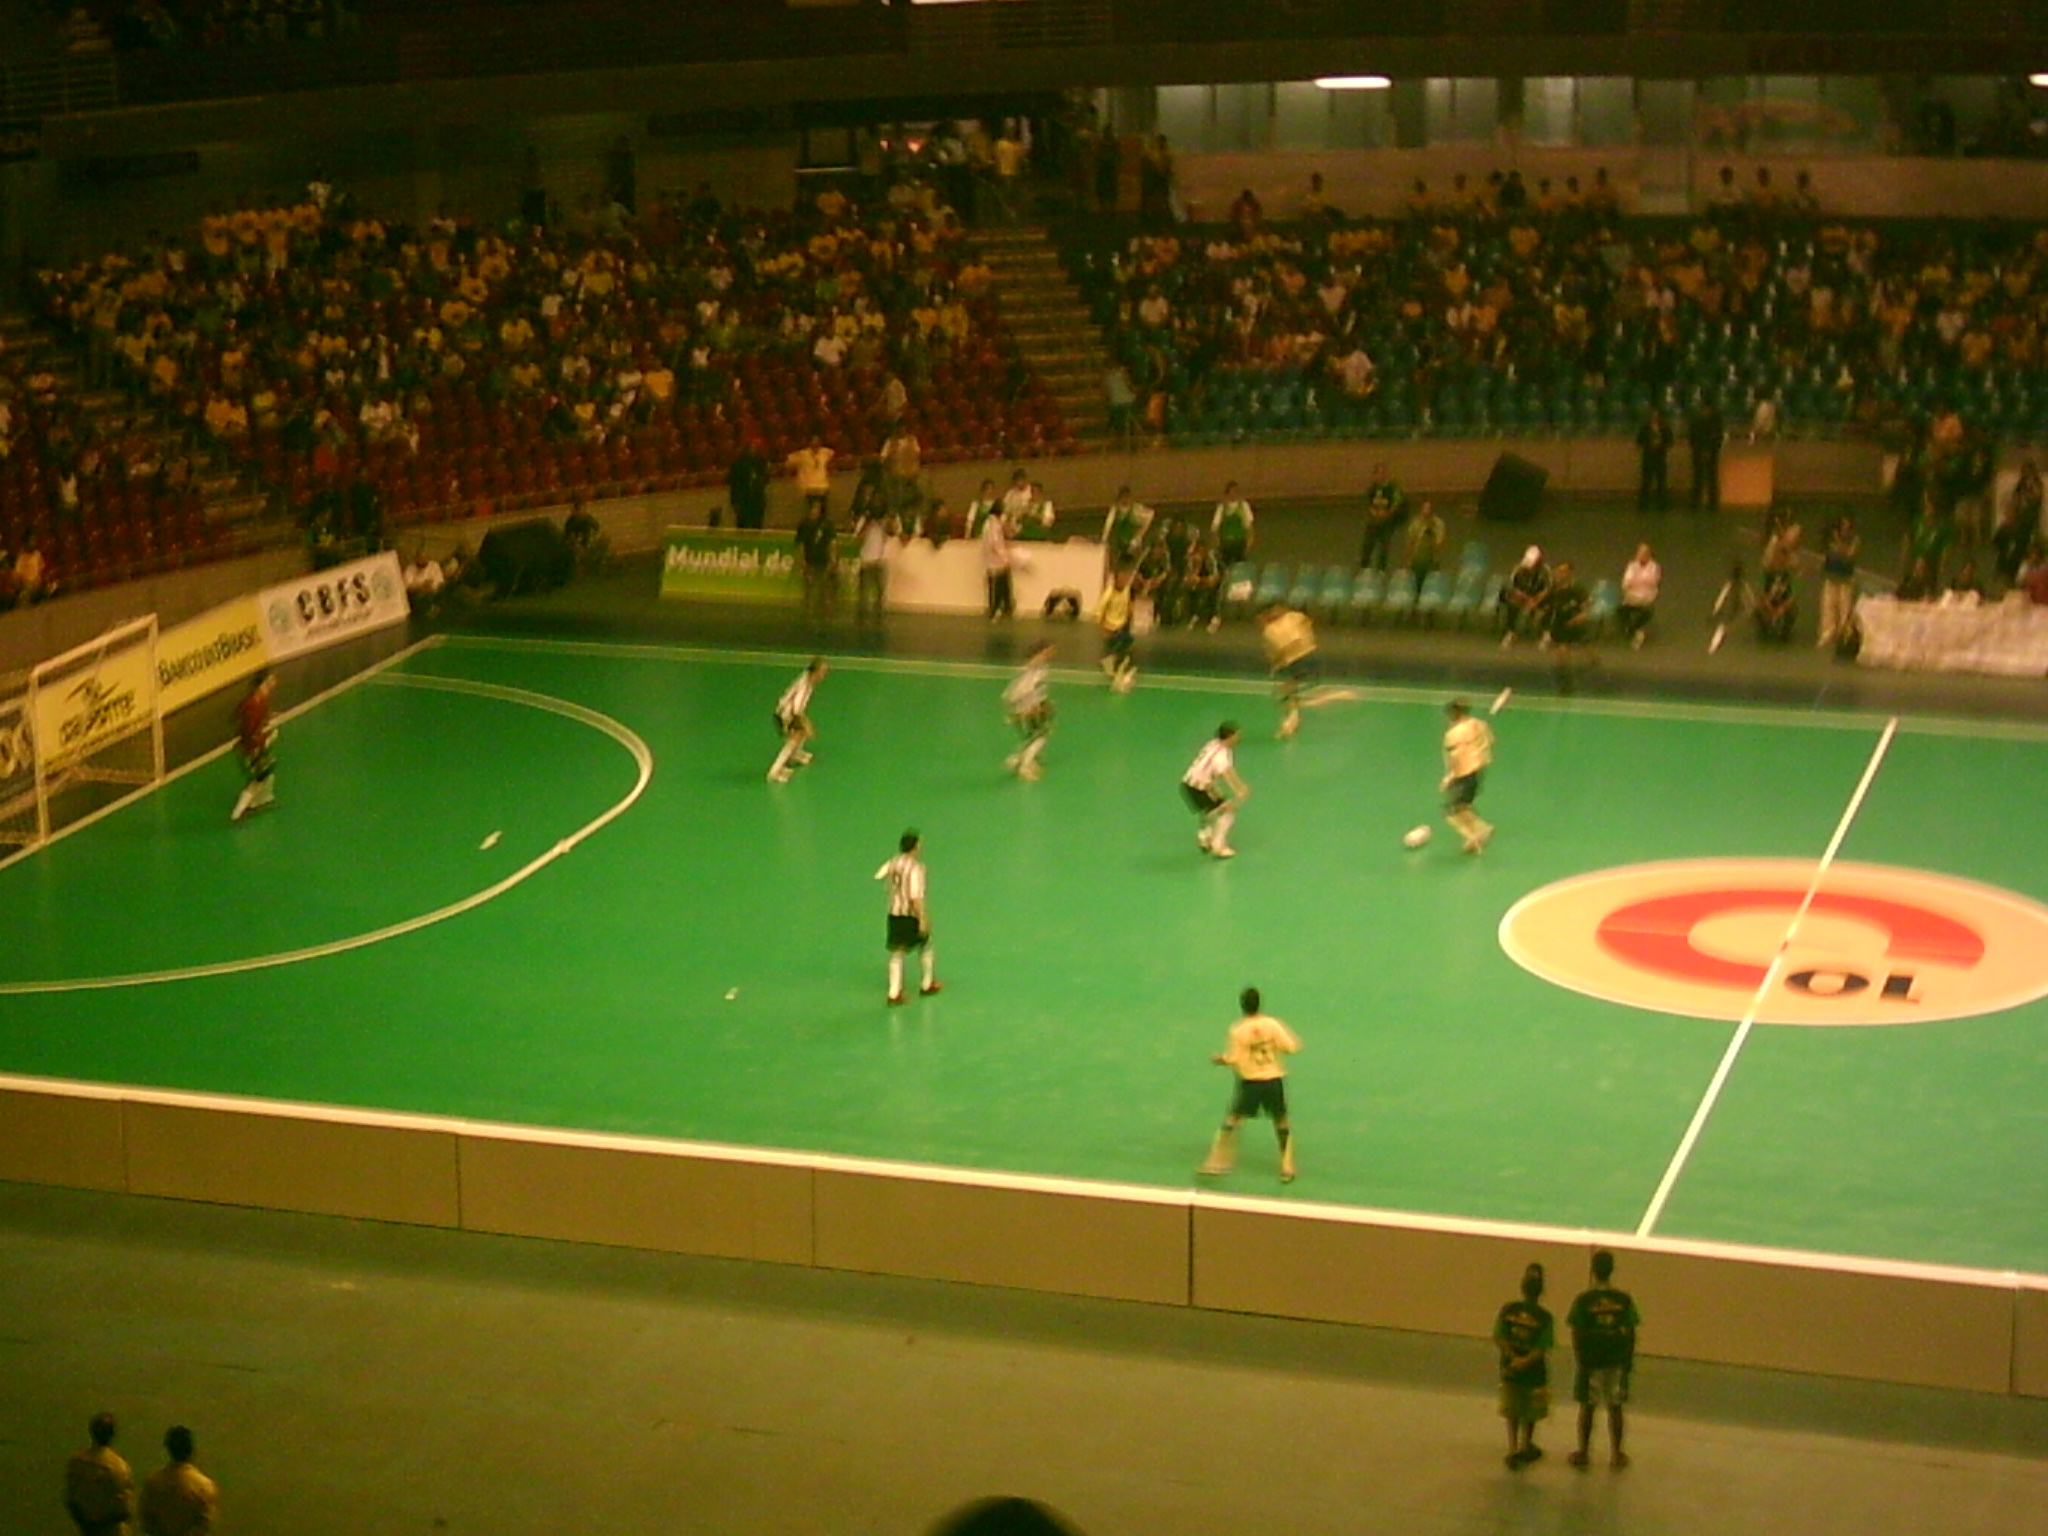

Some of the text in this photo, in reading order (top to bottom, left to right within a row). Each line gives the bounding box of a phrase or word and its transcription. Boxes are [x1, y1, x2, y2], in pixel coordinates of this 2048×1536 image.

[666, 545, 795, 572] Mundial de
[297, 571, 371, 622] CBFS
